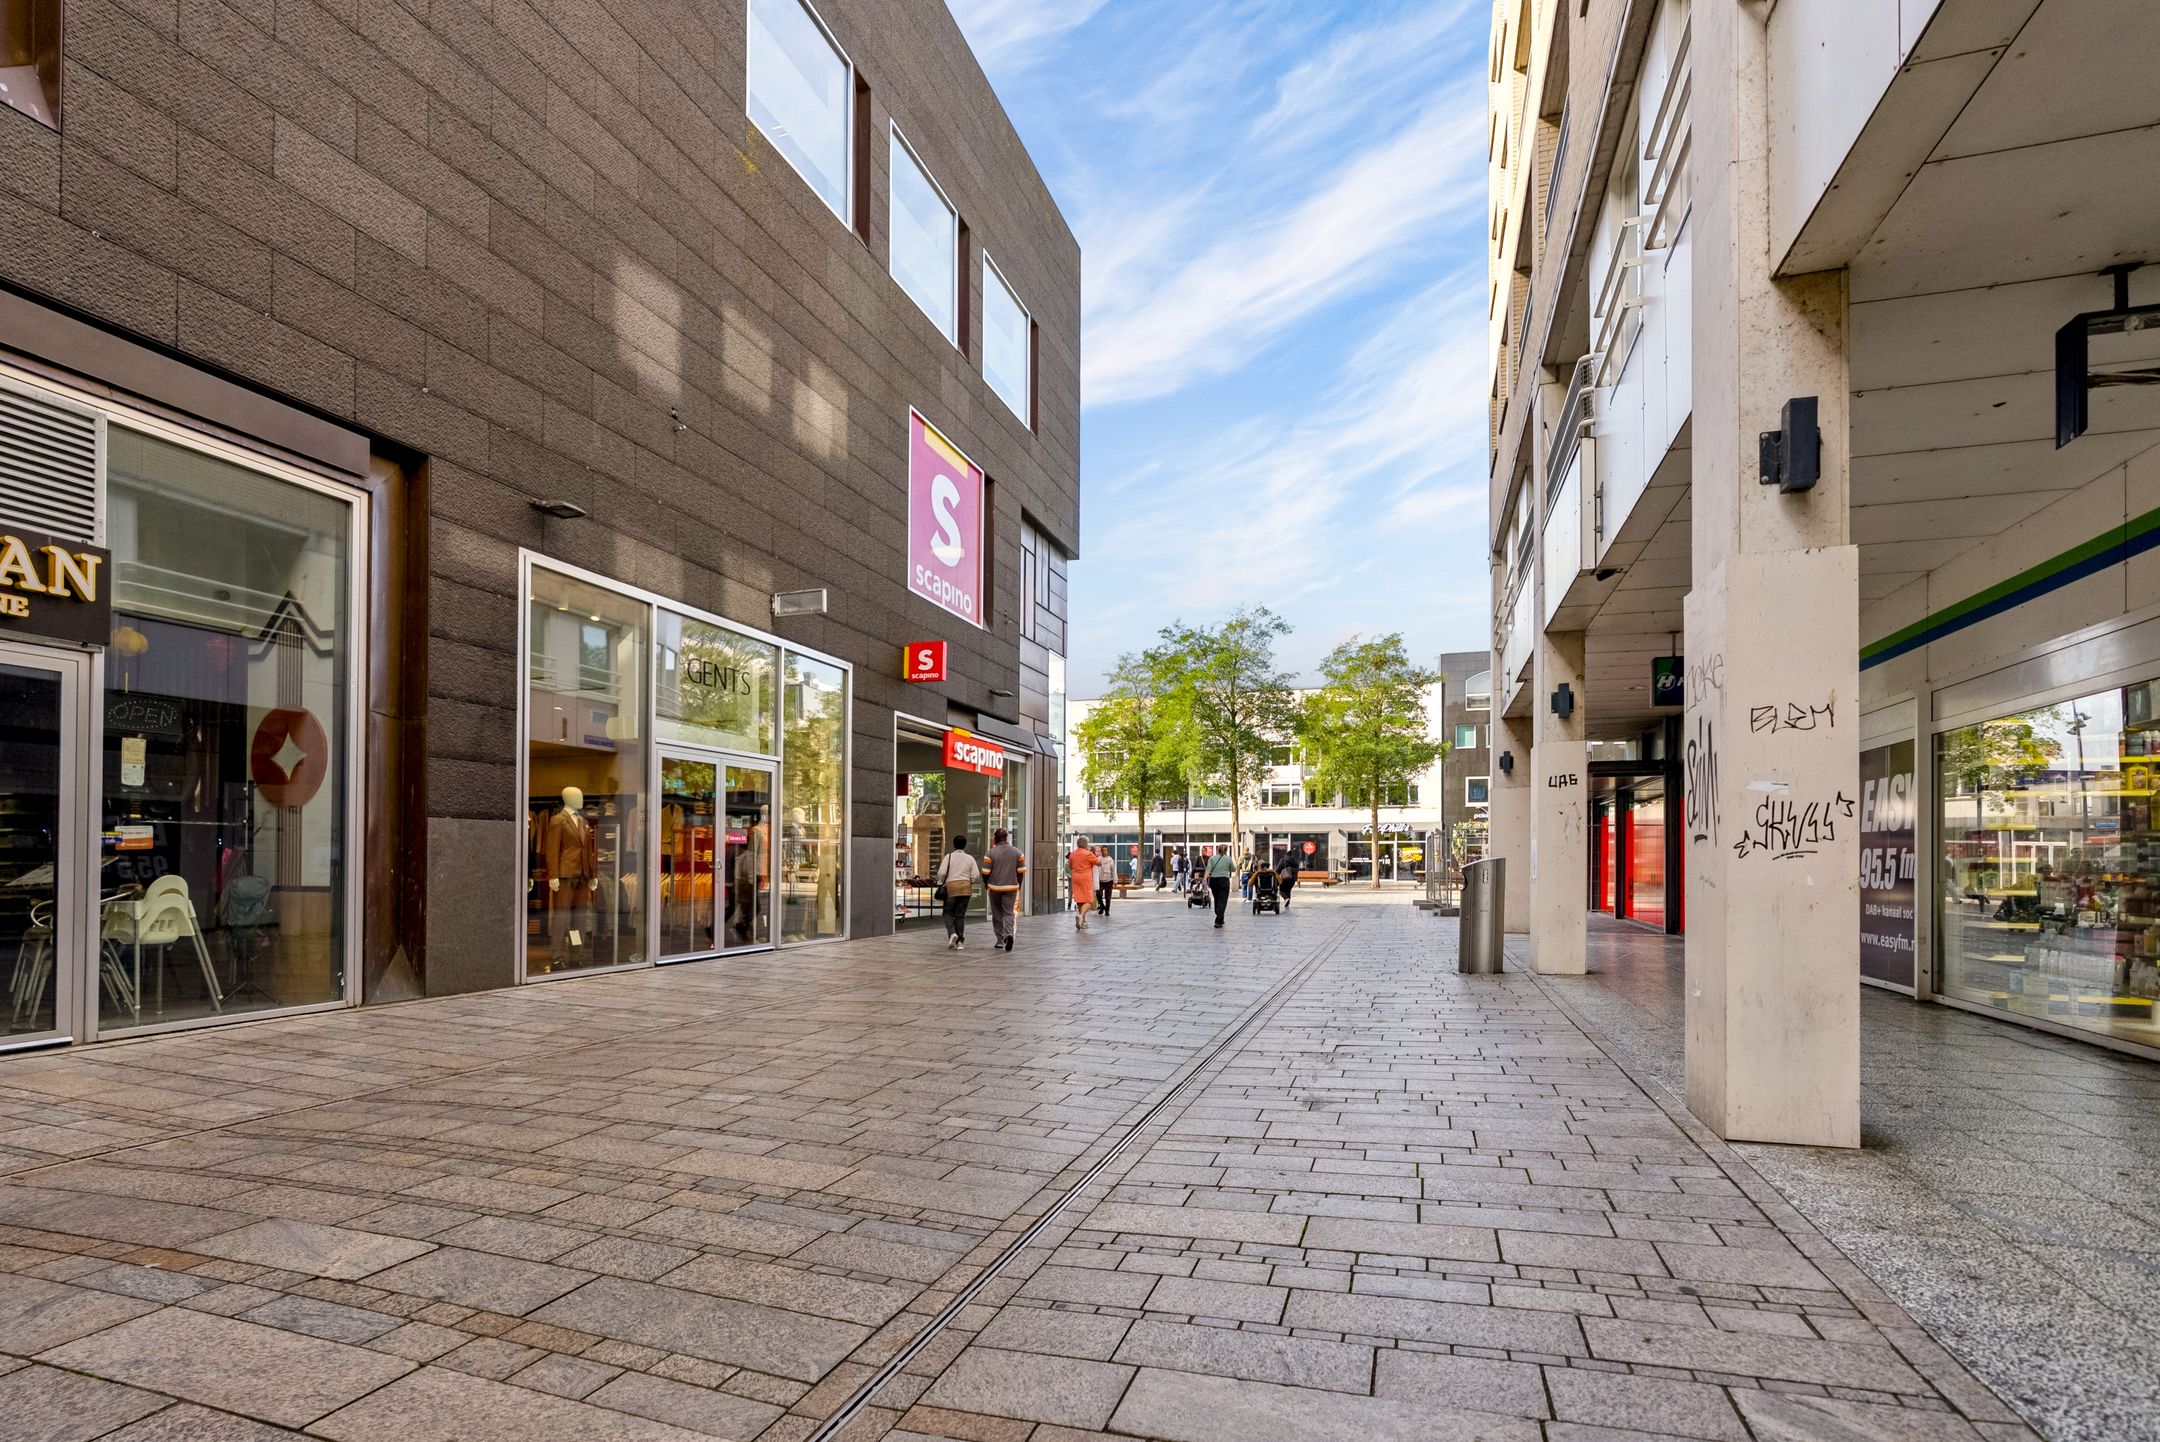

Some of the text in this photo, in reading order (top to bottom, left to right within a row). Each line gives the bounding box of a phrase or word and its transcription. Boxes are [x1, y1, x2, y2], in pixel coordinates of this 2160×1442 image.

[930, 474, 961, 567] S
[916, 564, 972, 614] scapino
[917, 649, 934, 671] S
[687, 657, 751, 696] GENTS
[911, 672, 939, 681] scapino
[112, 705, 174, 726] OPEN
[953, 741, 1004, 773] scapino
[1860, 848, 1897, 890] 95.5
[1865, 903, 1882, 916] DAB+
[1881, 904, 1902, 919] kanaal
